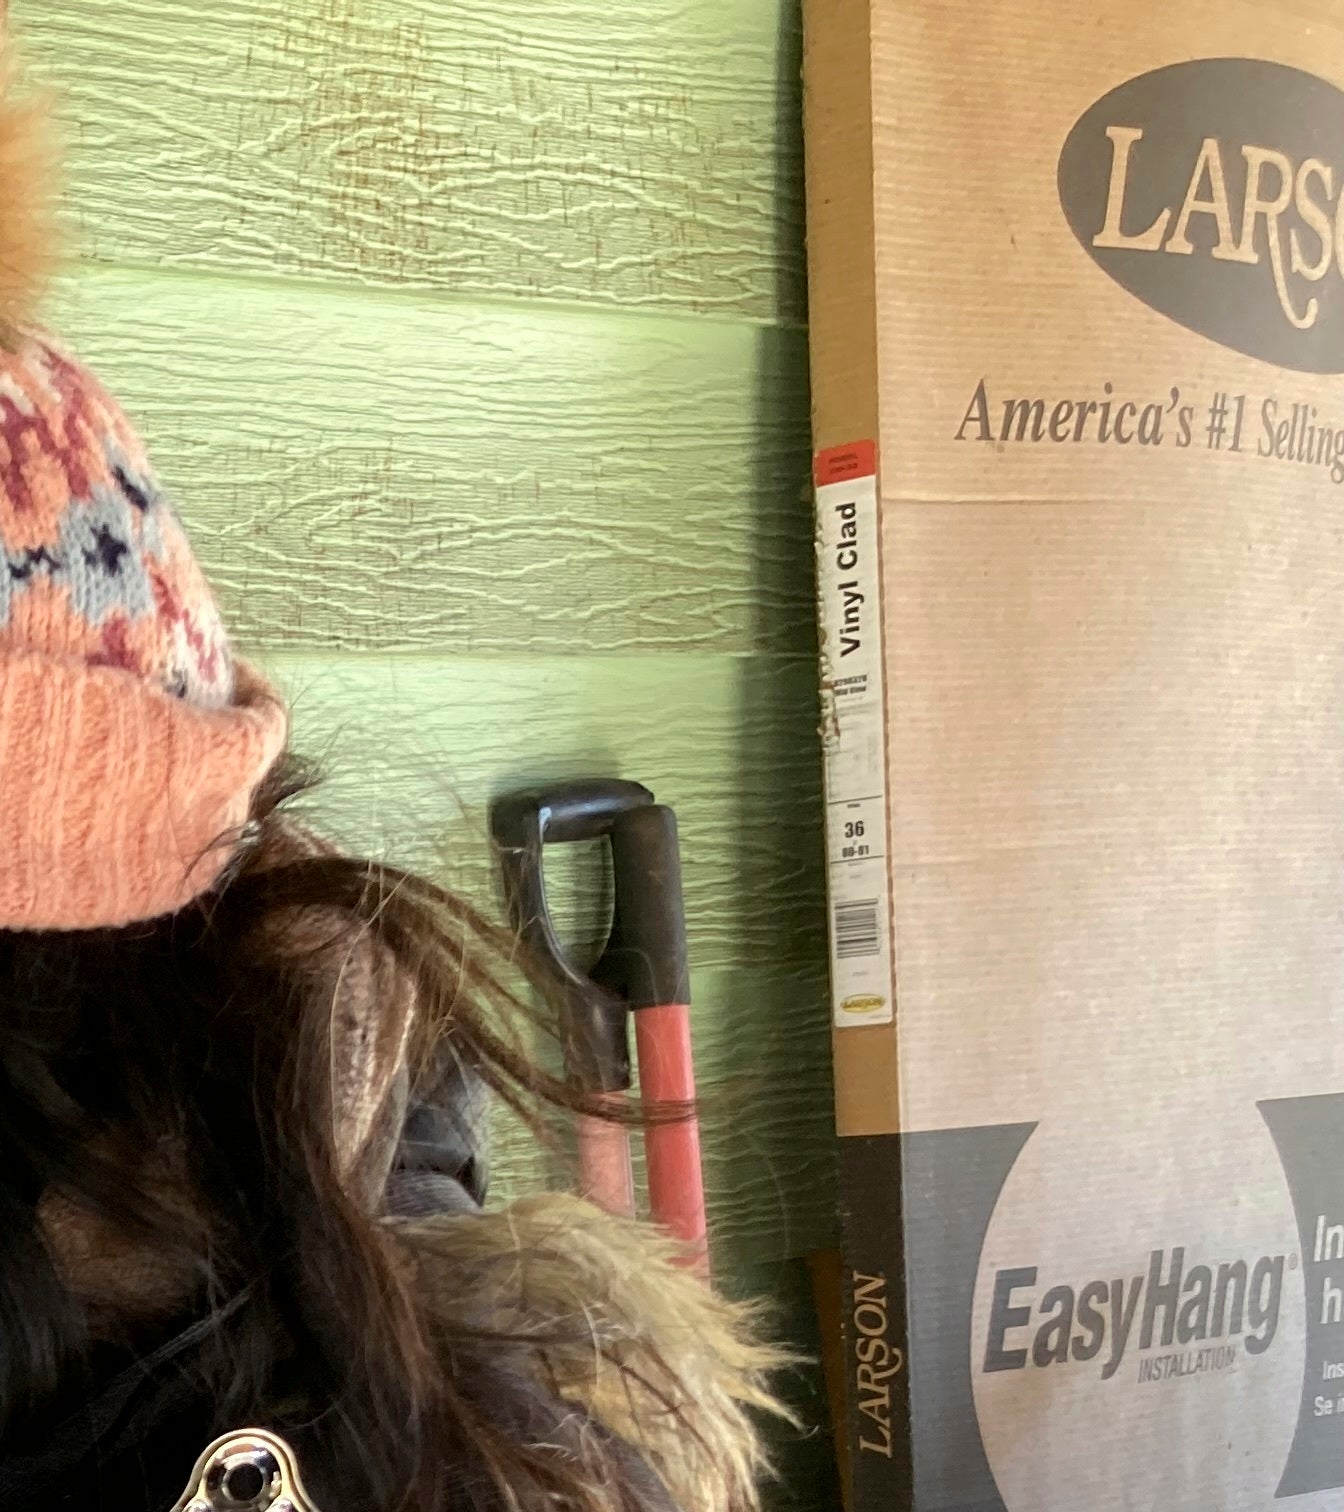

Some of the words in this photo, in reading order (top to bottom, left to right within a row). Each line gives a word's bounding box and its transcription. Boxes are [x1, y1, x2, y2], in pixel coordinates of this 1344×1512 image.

[1093, 125, 1344, 329] LARS
[954, 378, 1194, 447] America's
[1206, 391, 1245, 452] #1
[1257, 397, 1344, 484] Selling
[835, 501, 859, 571] Clad
[837, 580, 865, 658] Vinyl
[844, 820, 865, 838] 36
[983, 1246, 1285, 1381] EasyHang
[852, 1269, 904, 1459] LARSON
[1137, 1342, 1237, 1384] INSTALLATION
